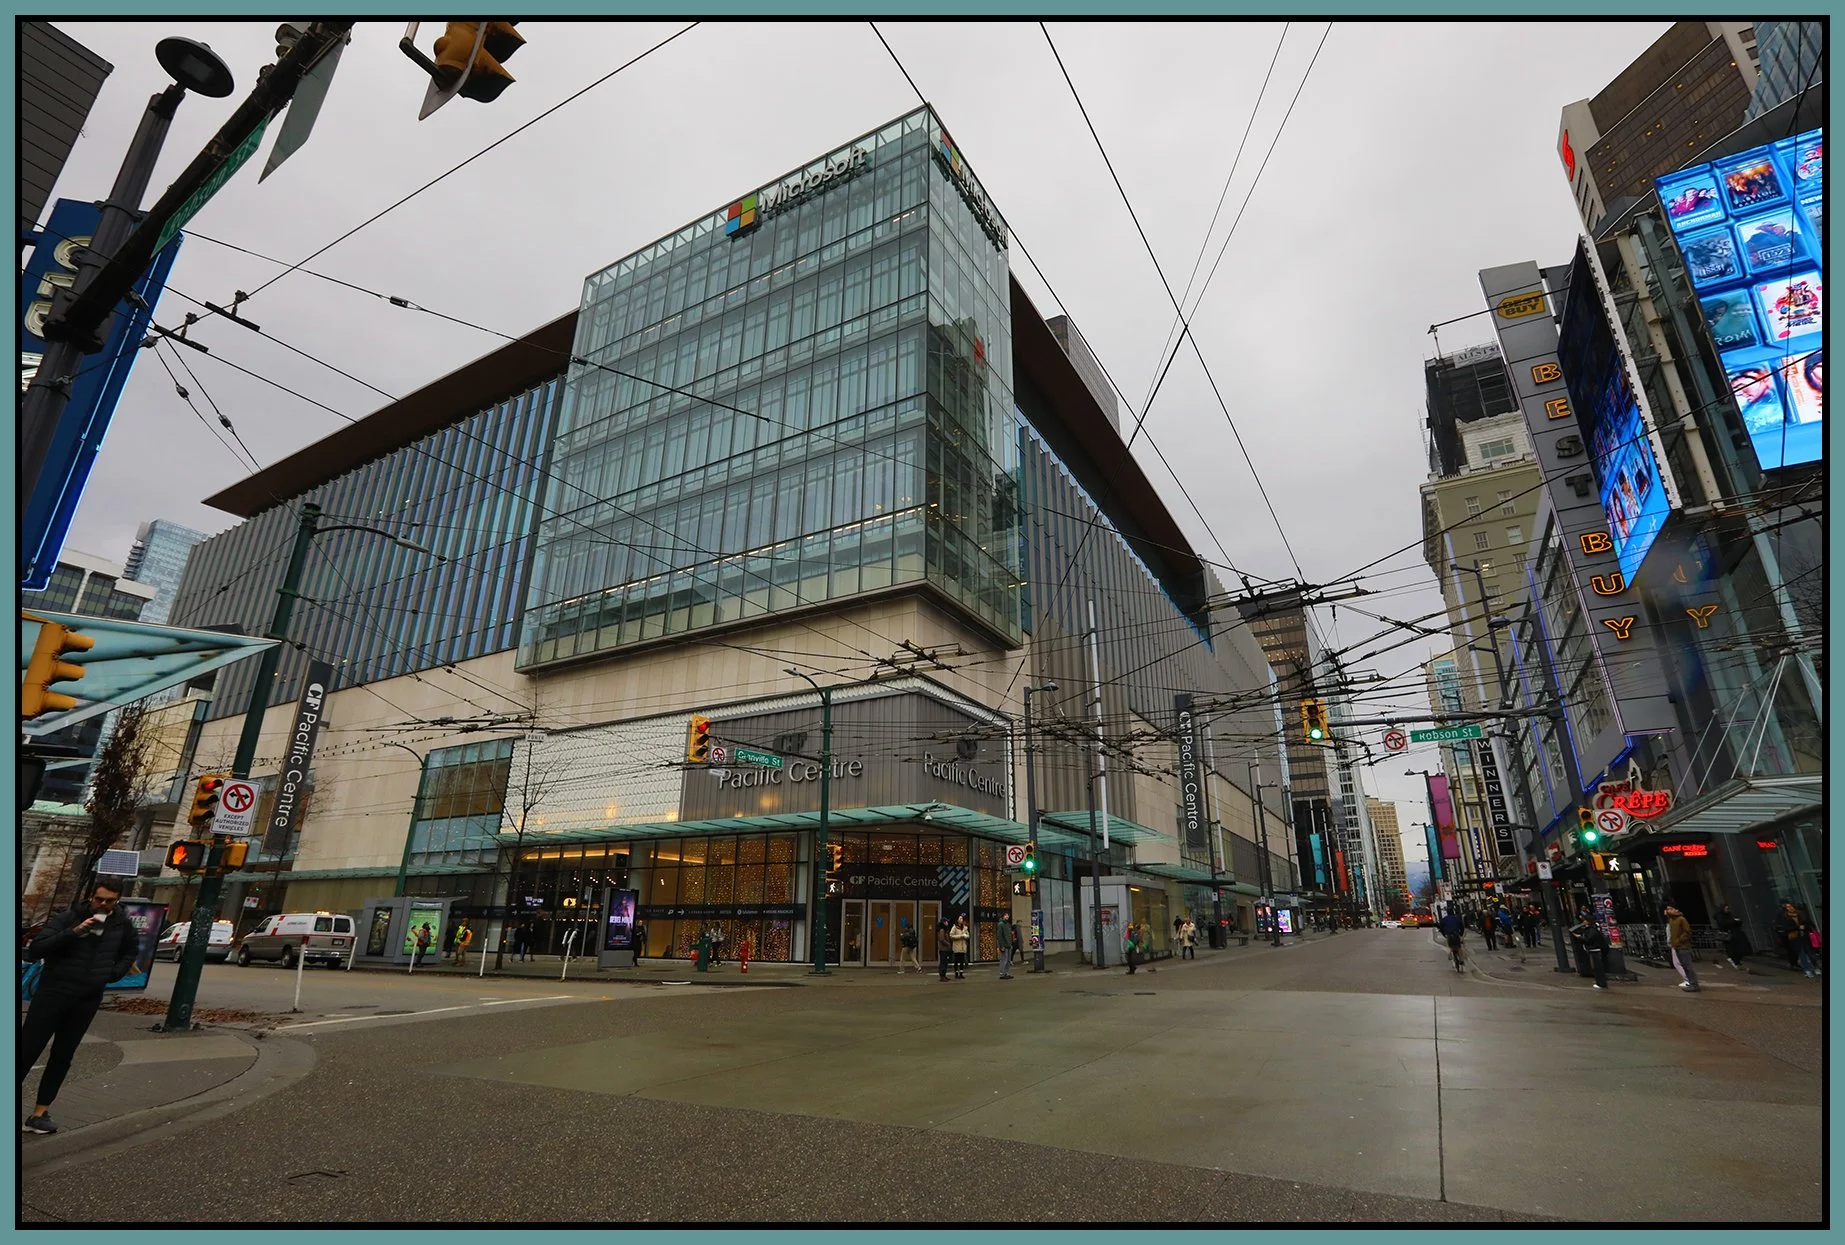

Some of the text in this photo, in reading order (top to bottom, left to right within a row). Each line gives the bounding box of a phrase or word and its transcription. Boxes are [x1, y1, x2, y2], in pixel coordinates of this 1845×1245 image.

[761, 147, 868, 213] Microsoft
[958, 163, 1009, 249] Microsoft
[1505, 303, 1539, 316] BUY
[1531, 362, 1635, 640] BEST BUY
[1419, 728, 1473, 741] Robson St
[275, 683, 324, 828] CF Pacific Centre
[737, 750, 781, 767] Granville St
[1181, 735, 1196, 779] Pacific
[719, 765, 783, 789] Pacific
[924, 751, 1005, 798] Pacific Centre
[1478, 740, 1509, 838] WINNERS
[1185, 782, 1198, 830] Centre
[1596, 790, 1668, 813] CRÊPE
[215, 818, 250, 827] AUTHORIZED
[218, 824, 244, 832] VEHICLES
[223, 813, 244, 821] EXCEPT
[849, 875, 939, 887] CF Pacific Centre
